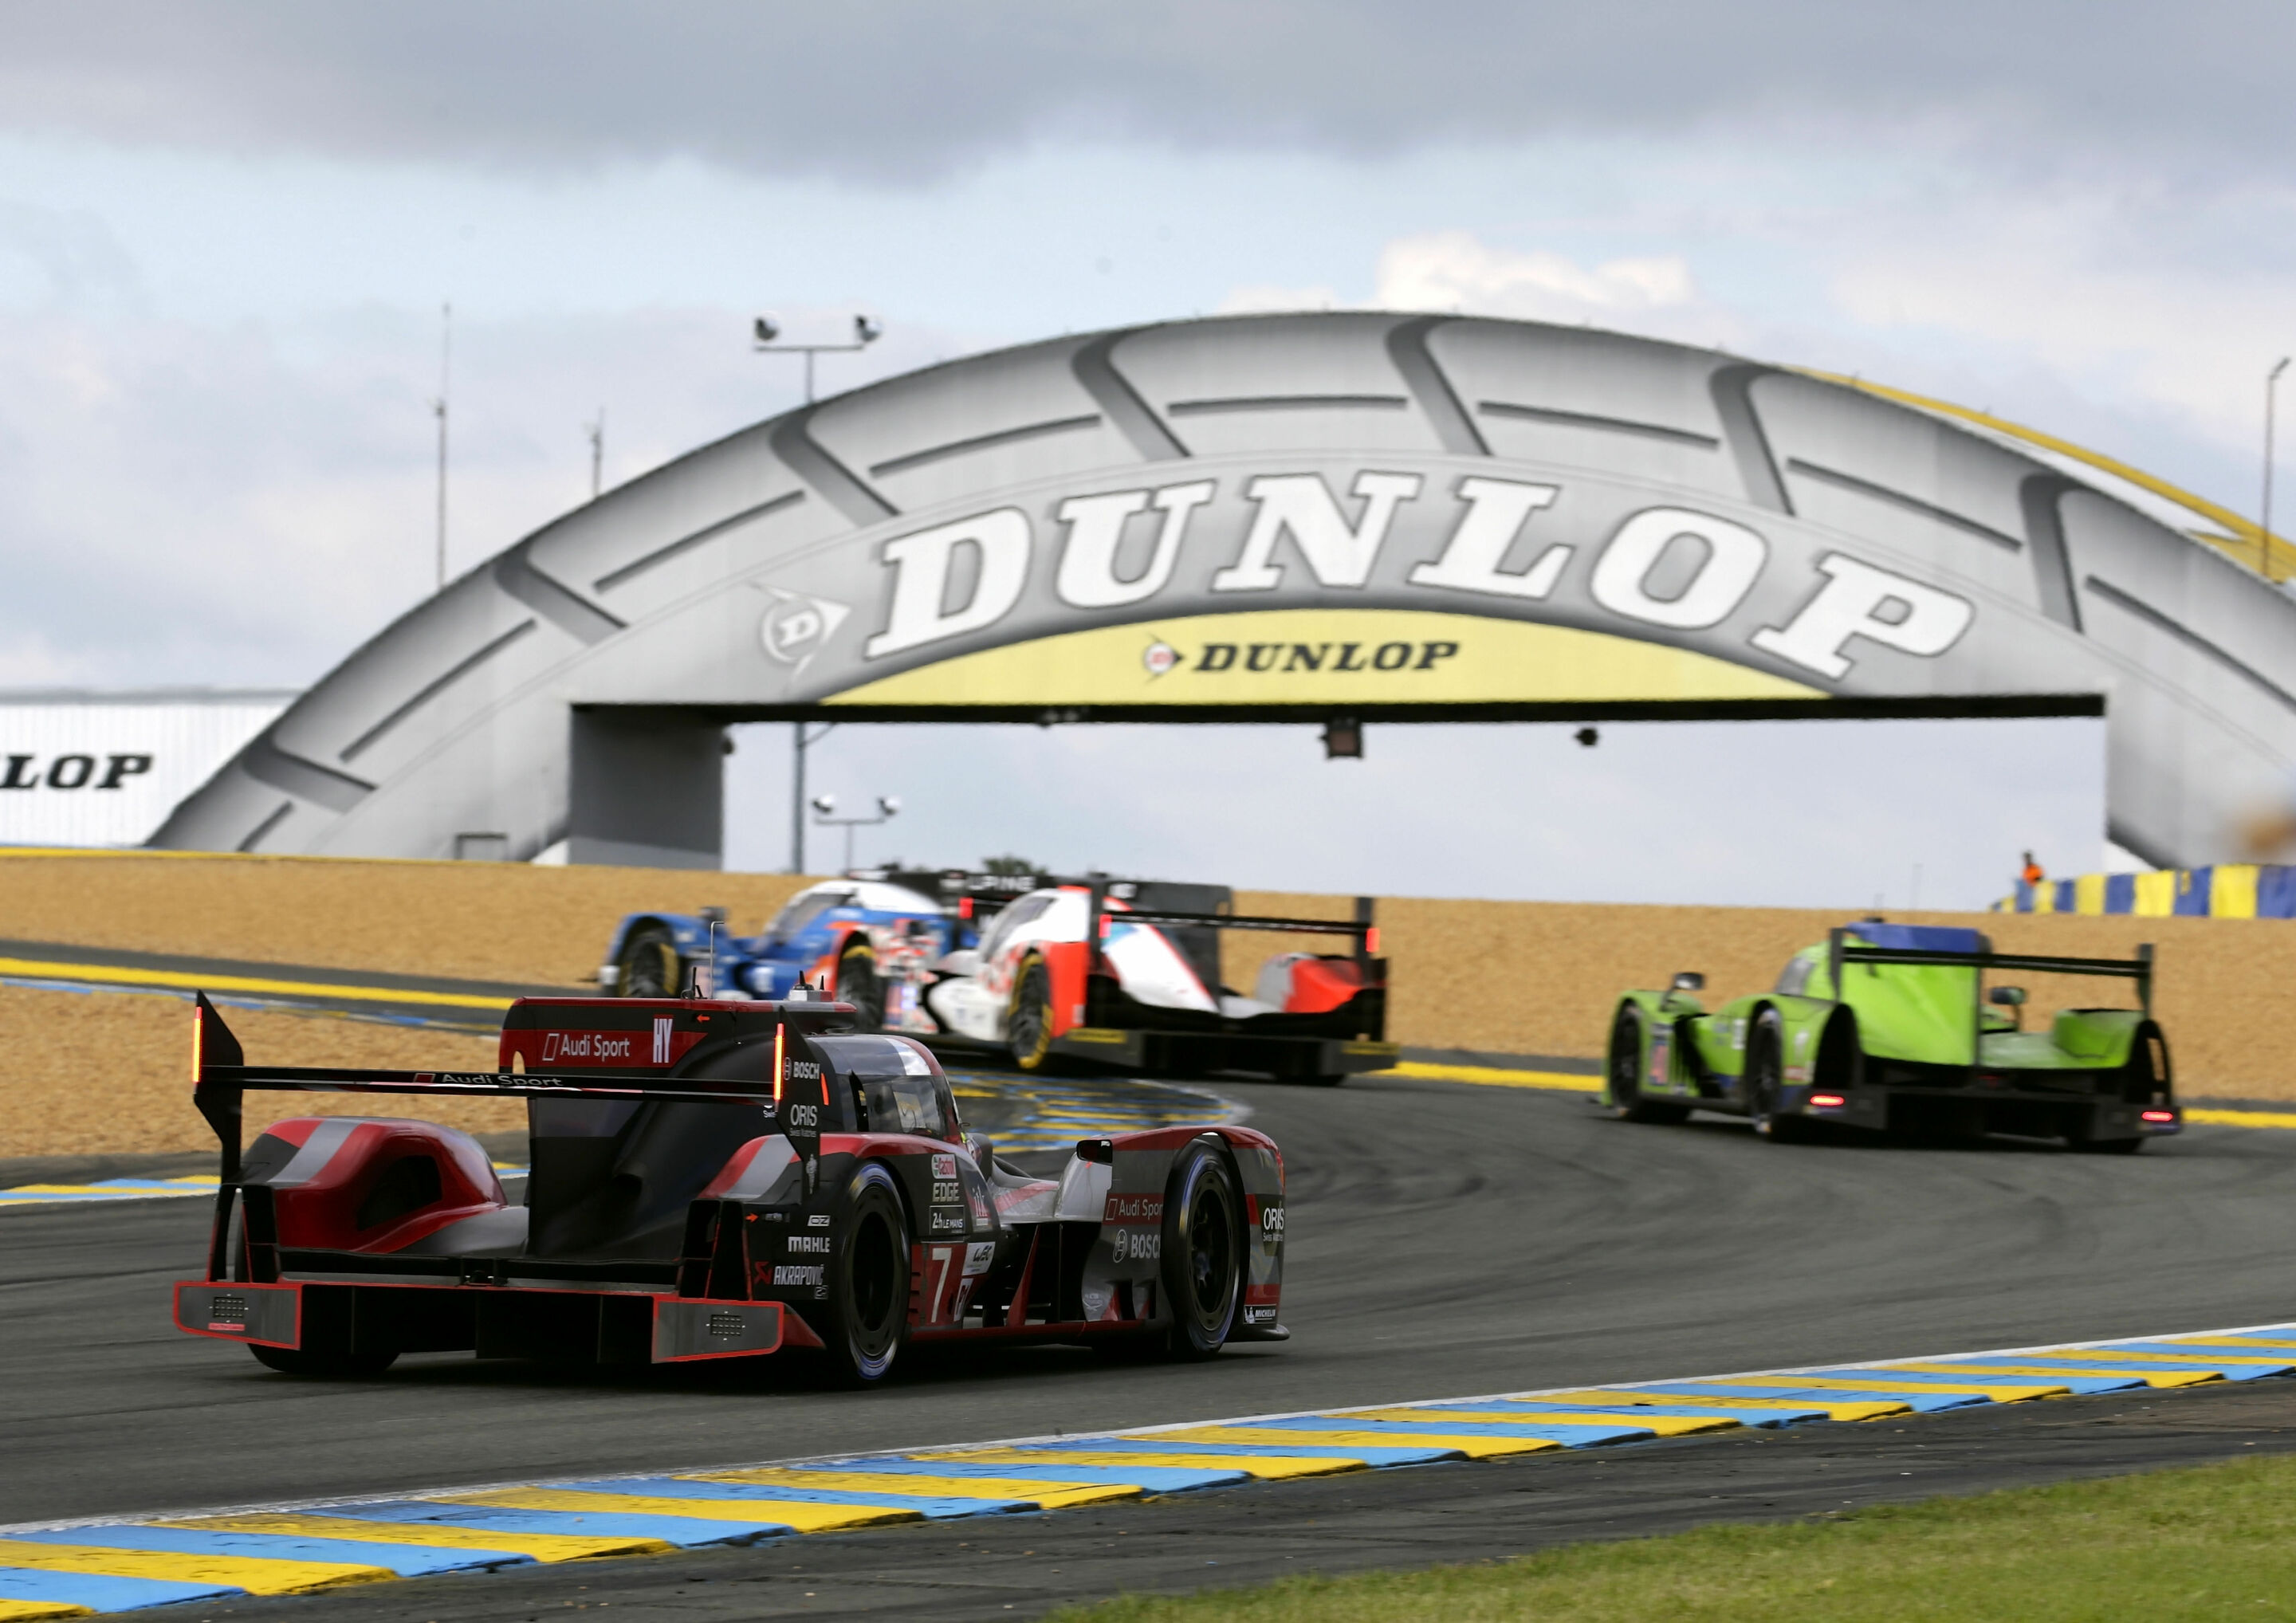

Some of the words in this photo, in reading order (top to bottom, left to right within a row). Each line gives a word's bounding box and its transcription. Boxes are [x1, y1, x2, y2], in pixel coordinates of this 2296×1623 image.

[864, 469, 1974, 680] DUNLOP
[1195, 641, 1460, 673] DUNLOP
[560, 1034, 591, 1057] Audi
[593, 1036, 631, 1062] Sport
[652, 1018, 674, 1063] HY
[441, 1073, 491, 1085] Audi
[497, 1075, 563, 1088] Sport
[792, 1061, 820, 1079] BOSCH
[790, 1103, 818, 1126] ORIS
[932, 1181, 961, 1203] EDGE
[1119, 1199, 1140, 1217] Audi
[1142, 1198, 1163, 1220] Spor
[1263, 1207, 1285, 1231] ORIS
[788, 1236, 831, 1253] MAHLE
[1130, 1234, 1161, 1259] BOSC
[931, 1247, 953, 1323] 7
